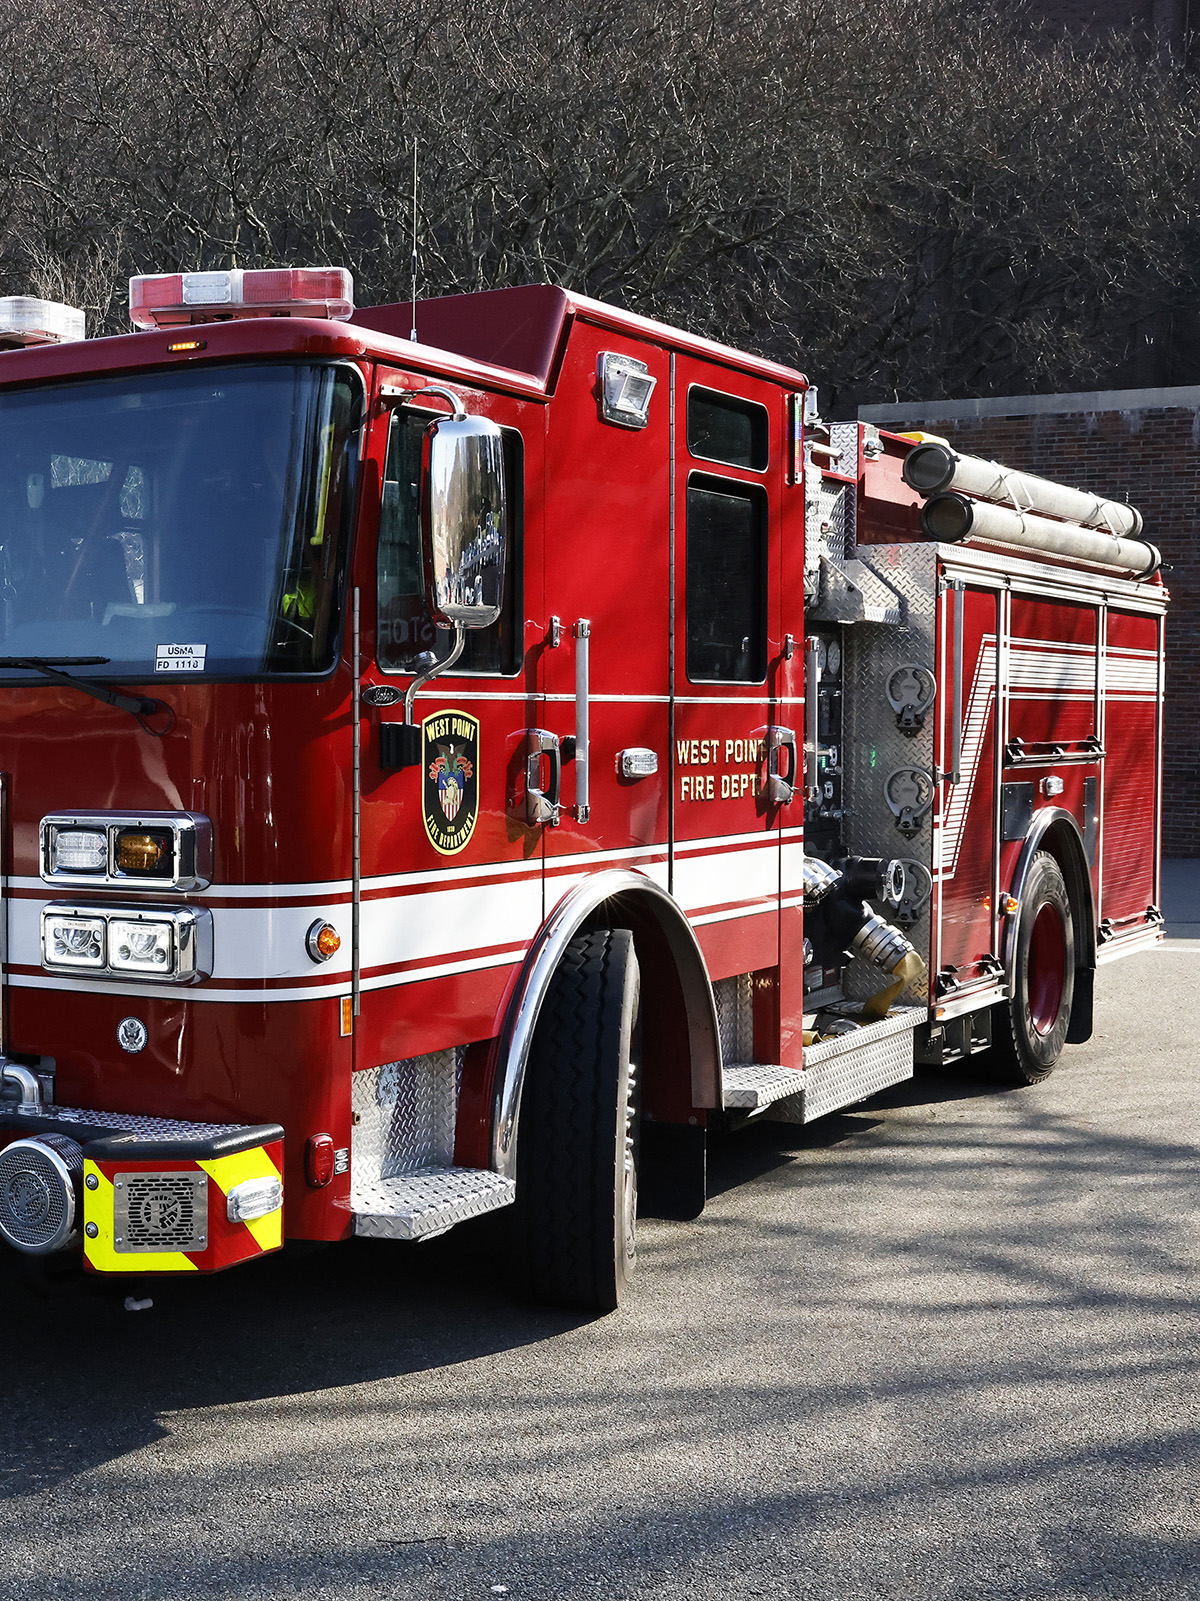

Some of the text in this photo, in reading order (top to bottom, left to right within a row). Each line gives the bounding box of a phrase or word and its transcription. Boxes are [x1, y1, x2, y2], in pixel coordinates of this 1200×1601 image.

[168, 647, 194, 655] USMA
[158, 661, 169, 669] FD
[426, 718, 476, 742] WEST POINT
[677, 739, 767, 764] WEST POINT
[681, 776, 715, 801] FIRE
[427, 811, 474, 849] FIRE DEPARTMENT
